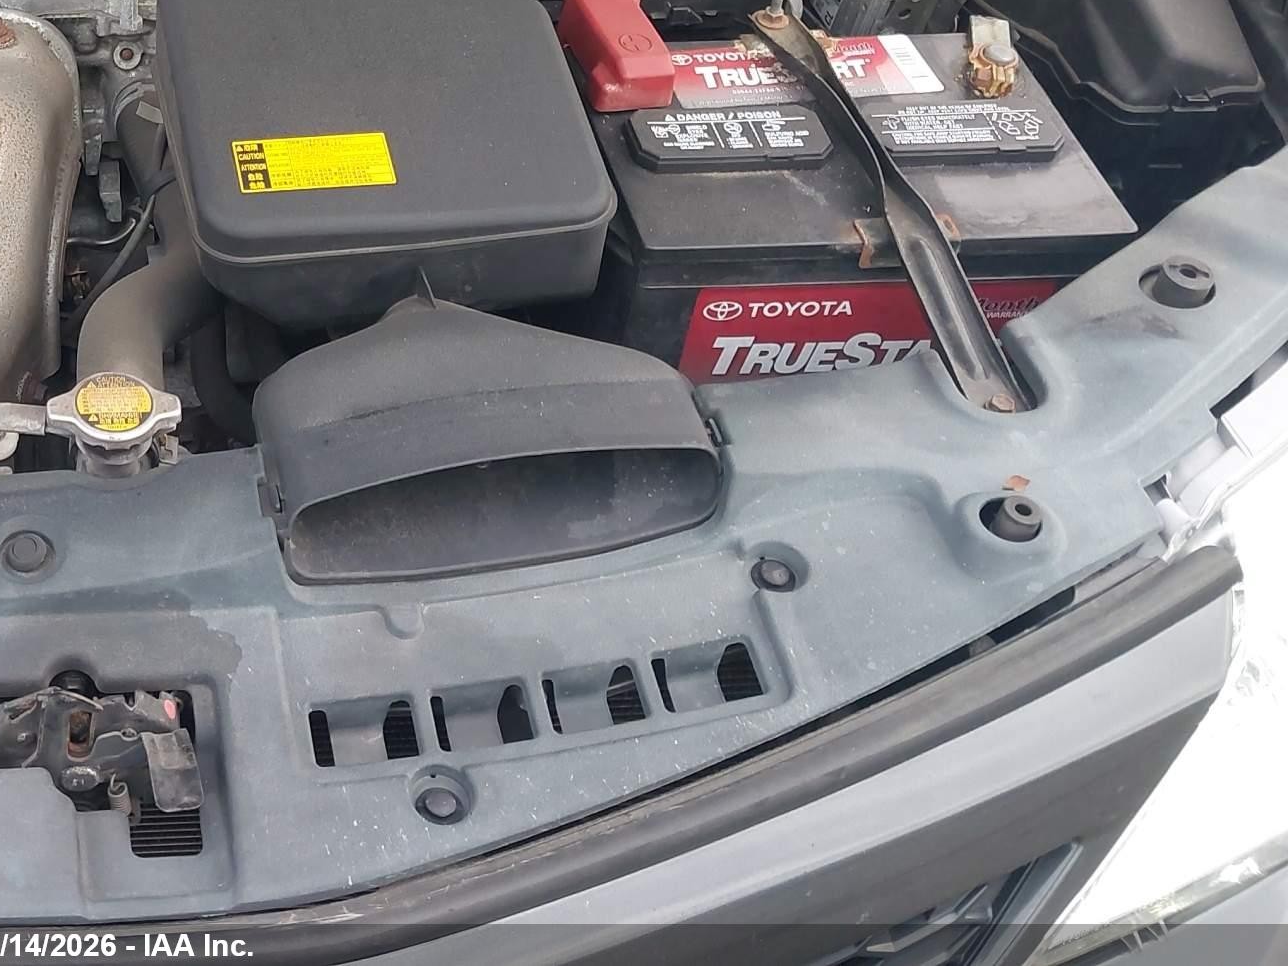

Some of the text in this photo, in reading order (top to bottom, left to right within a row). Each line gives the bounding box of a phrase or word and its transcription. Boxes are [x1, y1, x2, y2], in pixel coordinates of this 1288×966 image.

[676, 113, 726, 122] DANGER
[736, 111, 782, 120] POISON
[238, 152, 265, 161] CAUTION
[748, 301, 854, 318] TOYOTA
